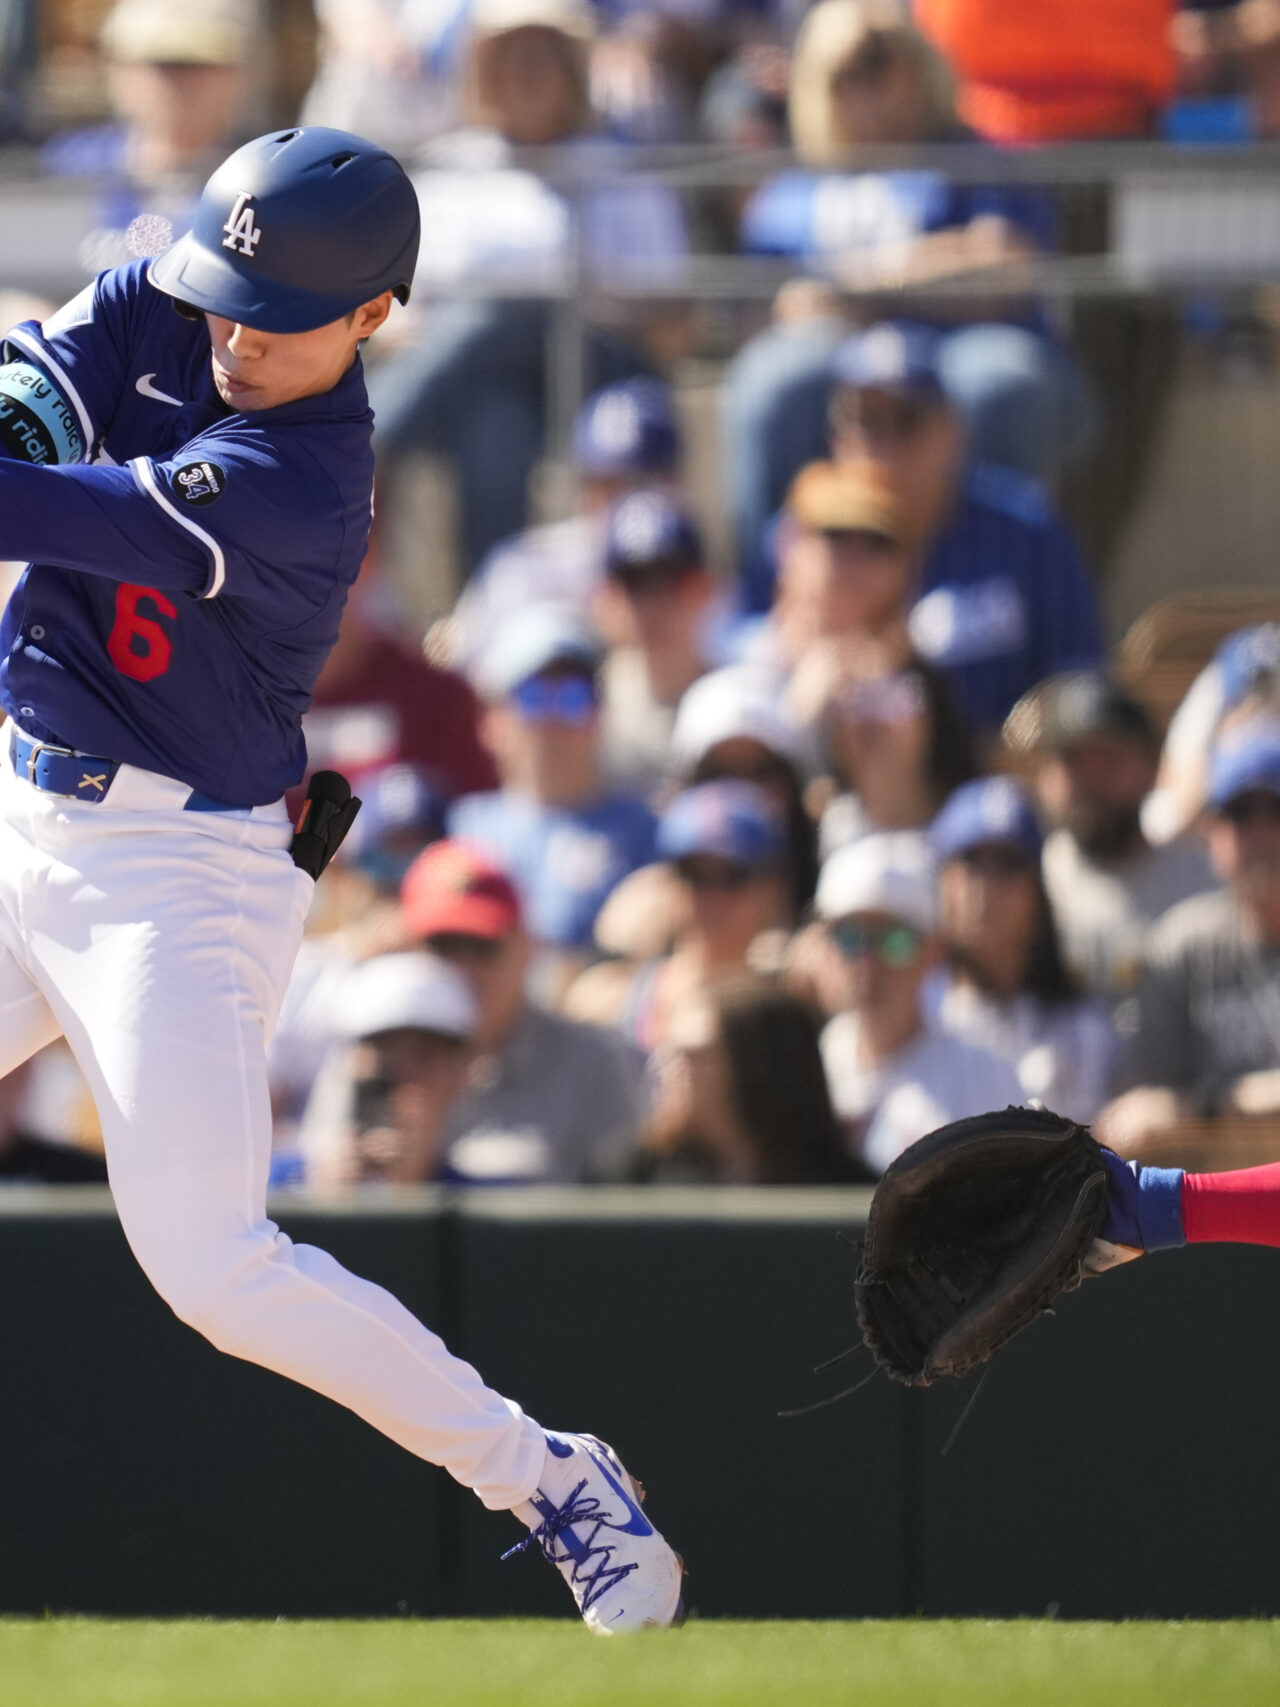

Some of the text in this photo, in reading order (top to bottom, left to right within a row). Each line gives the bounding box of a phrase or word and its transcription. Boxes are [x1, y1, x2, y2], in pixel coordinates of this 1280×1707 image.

[222, 190, 262, 257] LA
[178, 468, 210, 499] 34
[106, 581, 178, 683] 6
